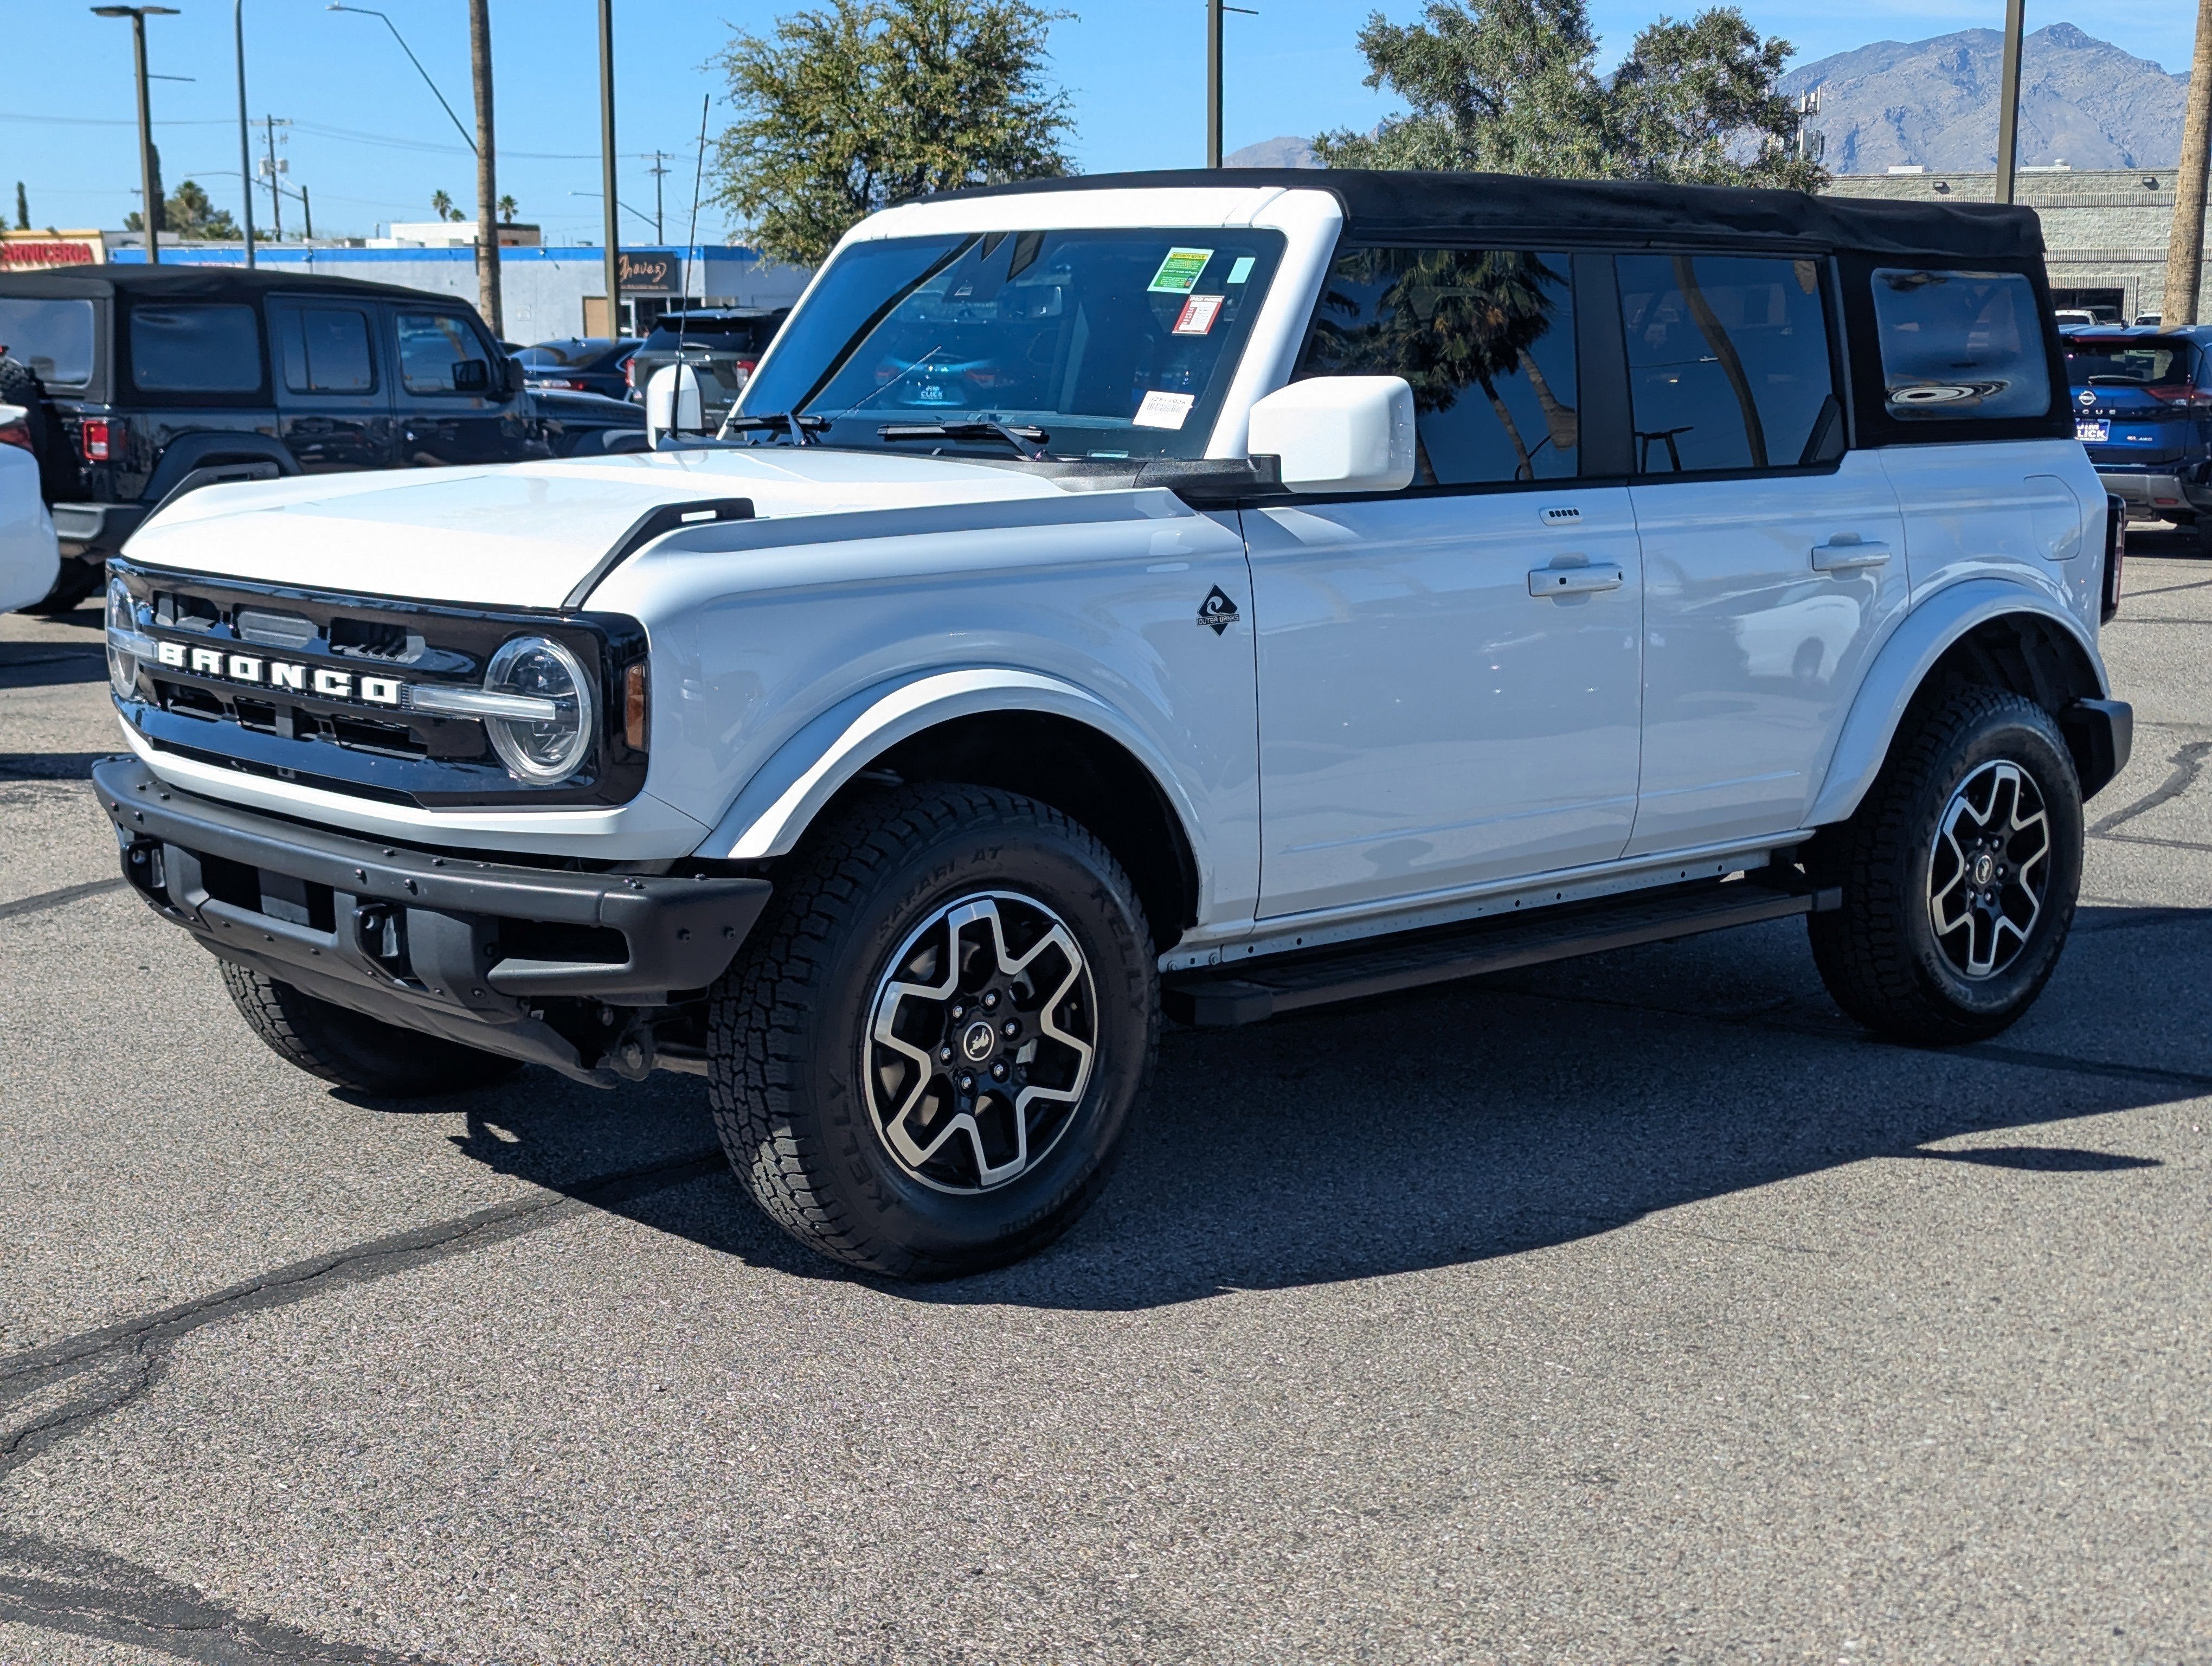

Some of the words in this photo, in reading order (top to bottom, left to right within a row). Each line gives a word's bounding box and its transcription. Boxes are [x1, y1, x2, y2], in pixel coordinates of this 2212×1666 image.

[2077, 430, 2106, 438] LICK
[158, 642, 401, 705] BRONCO
[828, 1068, 895, 1213] KELLY
